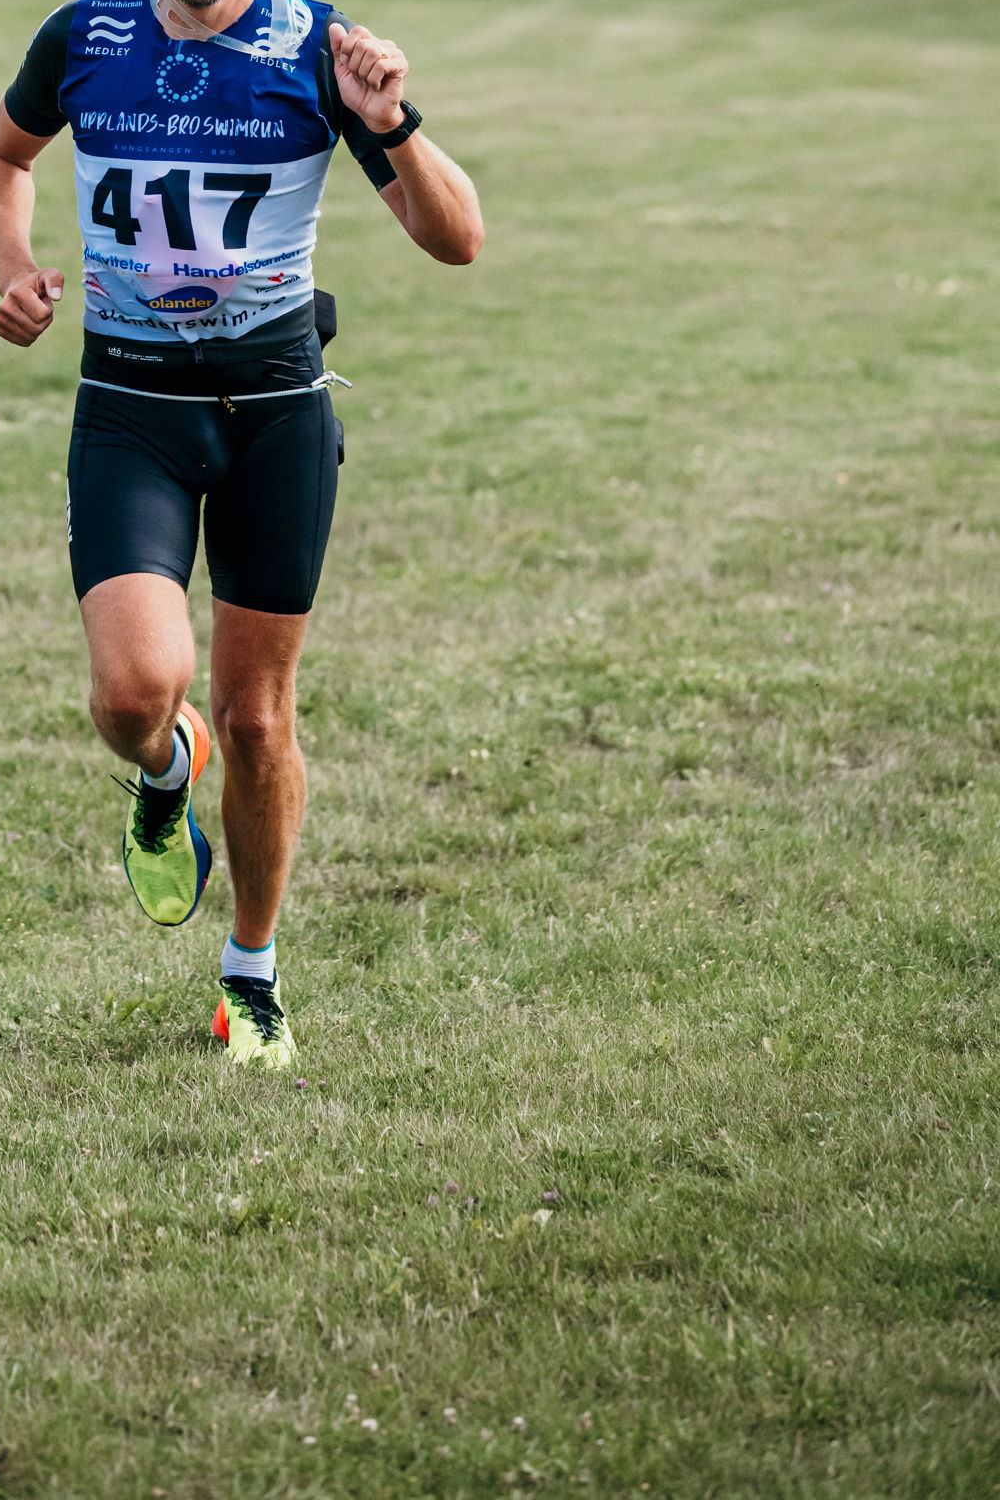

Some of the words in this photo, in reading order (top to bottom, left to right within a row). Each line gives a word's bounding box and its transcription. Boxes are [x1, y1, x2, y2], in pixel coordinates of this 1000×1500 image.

[85, 46, 130, 56] MEDLEY
[249, 55, 296, 73] MEDLEY
[92, 167, 272, 251] 417
[149, 296, 213, 309] olander
